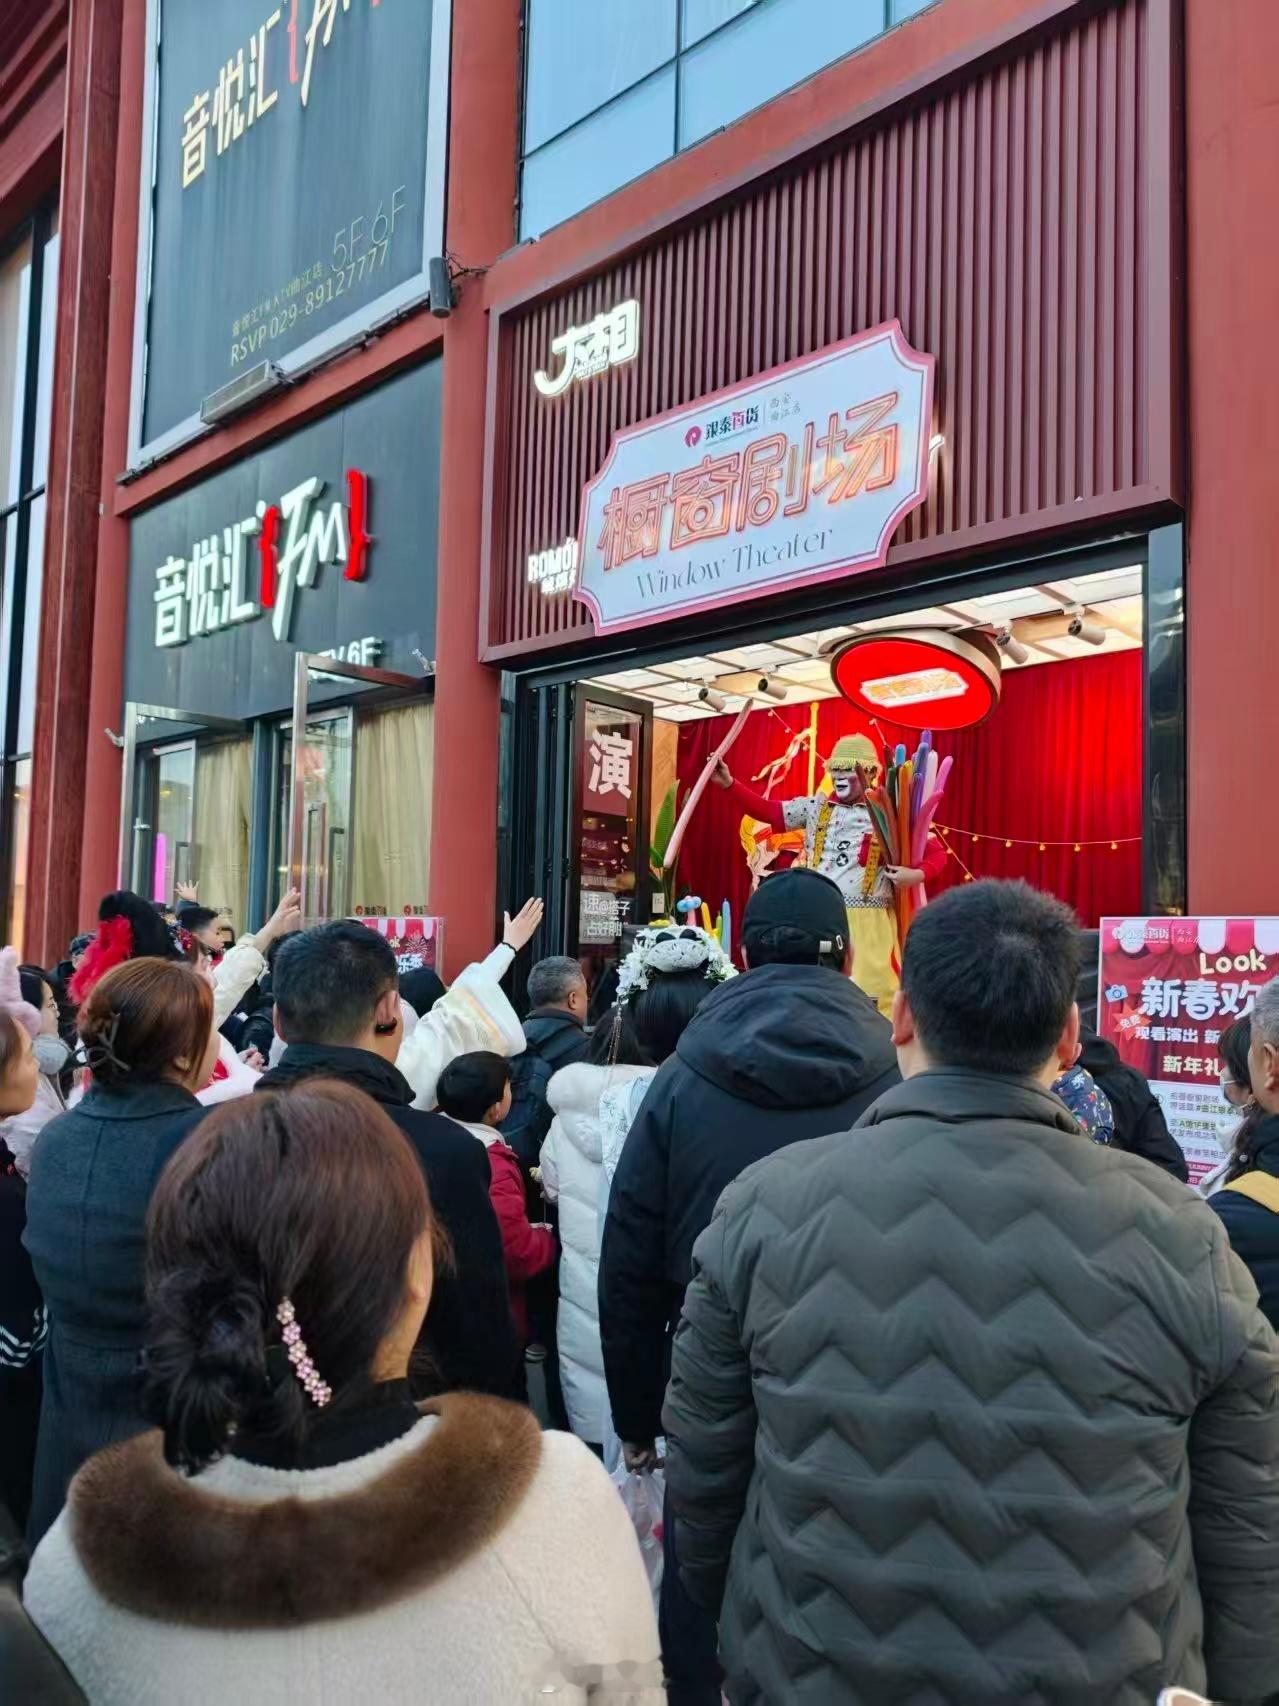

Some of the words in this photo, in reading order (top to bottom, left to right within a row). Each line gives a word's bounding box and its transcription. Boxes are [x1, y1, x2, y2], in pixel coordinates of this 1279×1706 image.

[230, 324, 268, 367] RSVP
[270, 238, 390, 339] 029-89127777
[598, 391, 899, 572] 橱窗剧场
[154, 515, 261, 648] 音悦汇
[636, 560, 727, 599] Window
[733, 528, 834, 573] Theater
[588, 728, 633, 799] 演
[1200, 949, 1267, 975] Look
[1135, 1026, 1198, 1044] 观看演出
